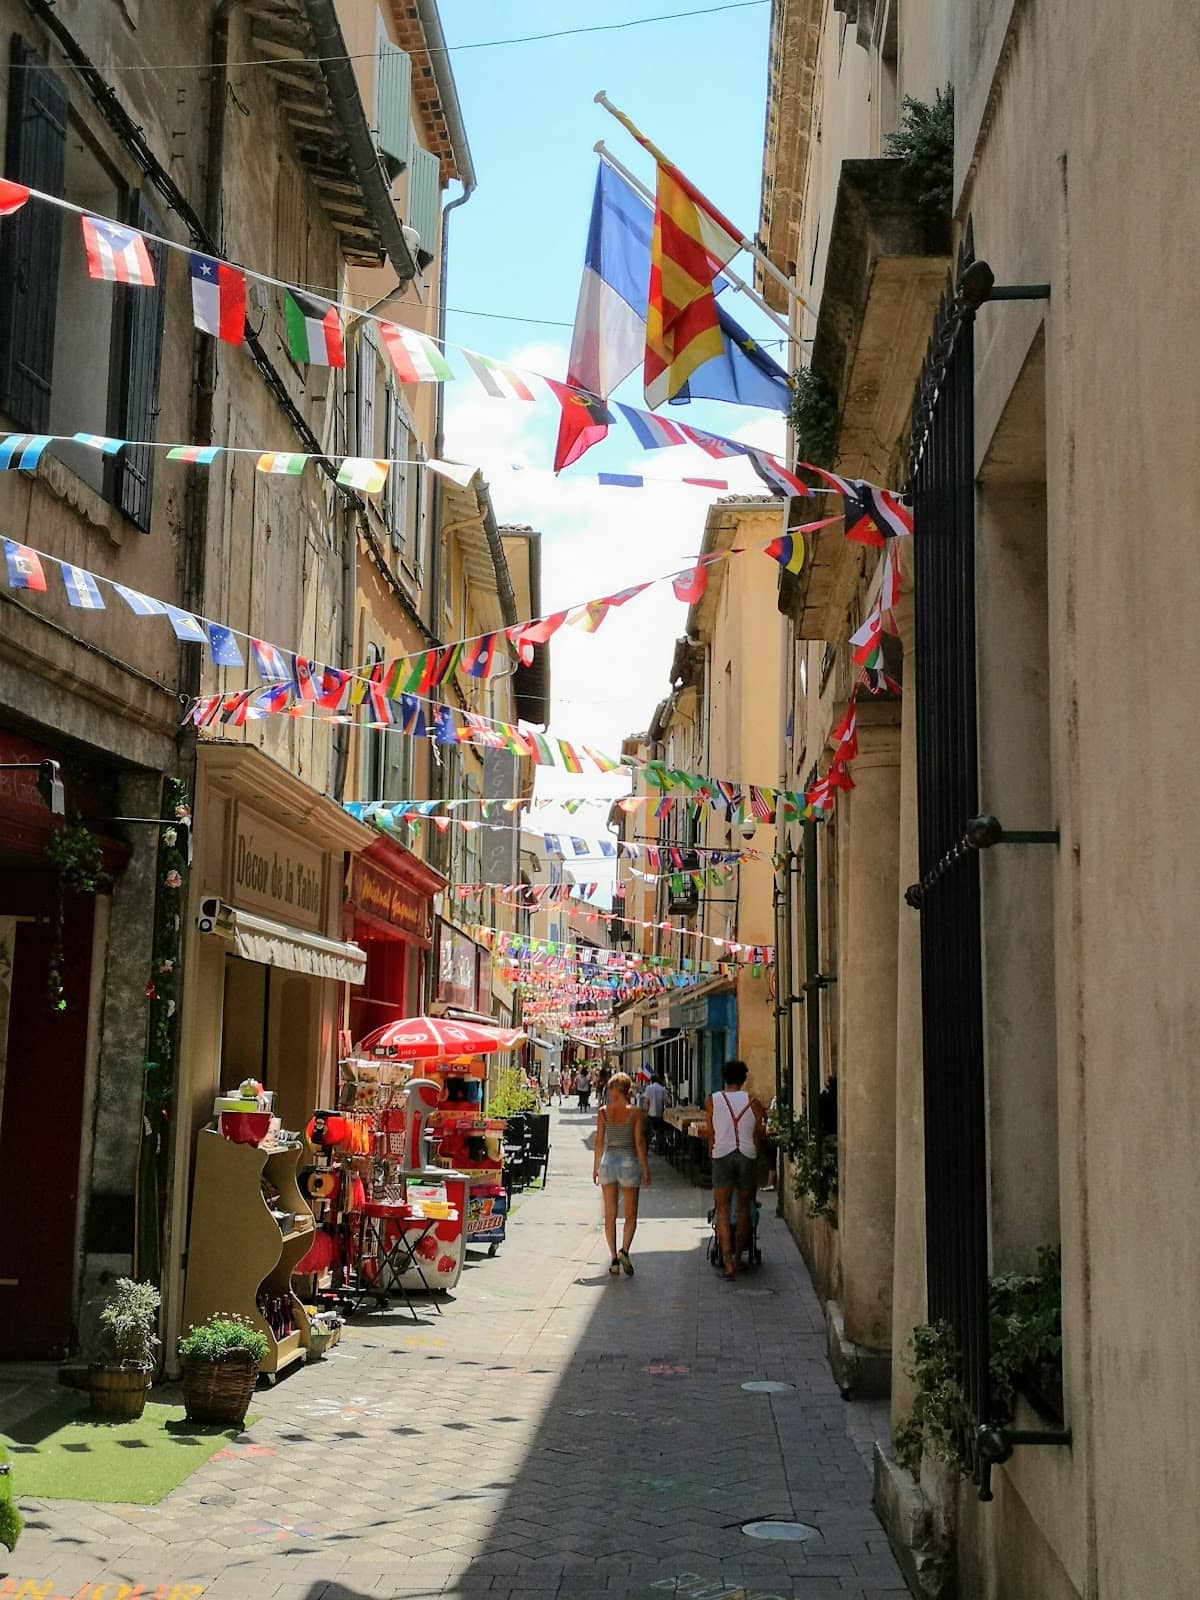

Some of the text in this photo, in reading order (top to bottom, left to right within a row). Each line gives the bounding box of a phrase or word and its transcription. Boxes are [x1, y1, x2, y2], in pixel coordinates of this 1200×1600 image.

[236, 834, 319, 913] Décor de la Table
